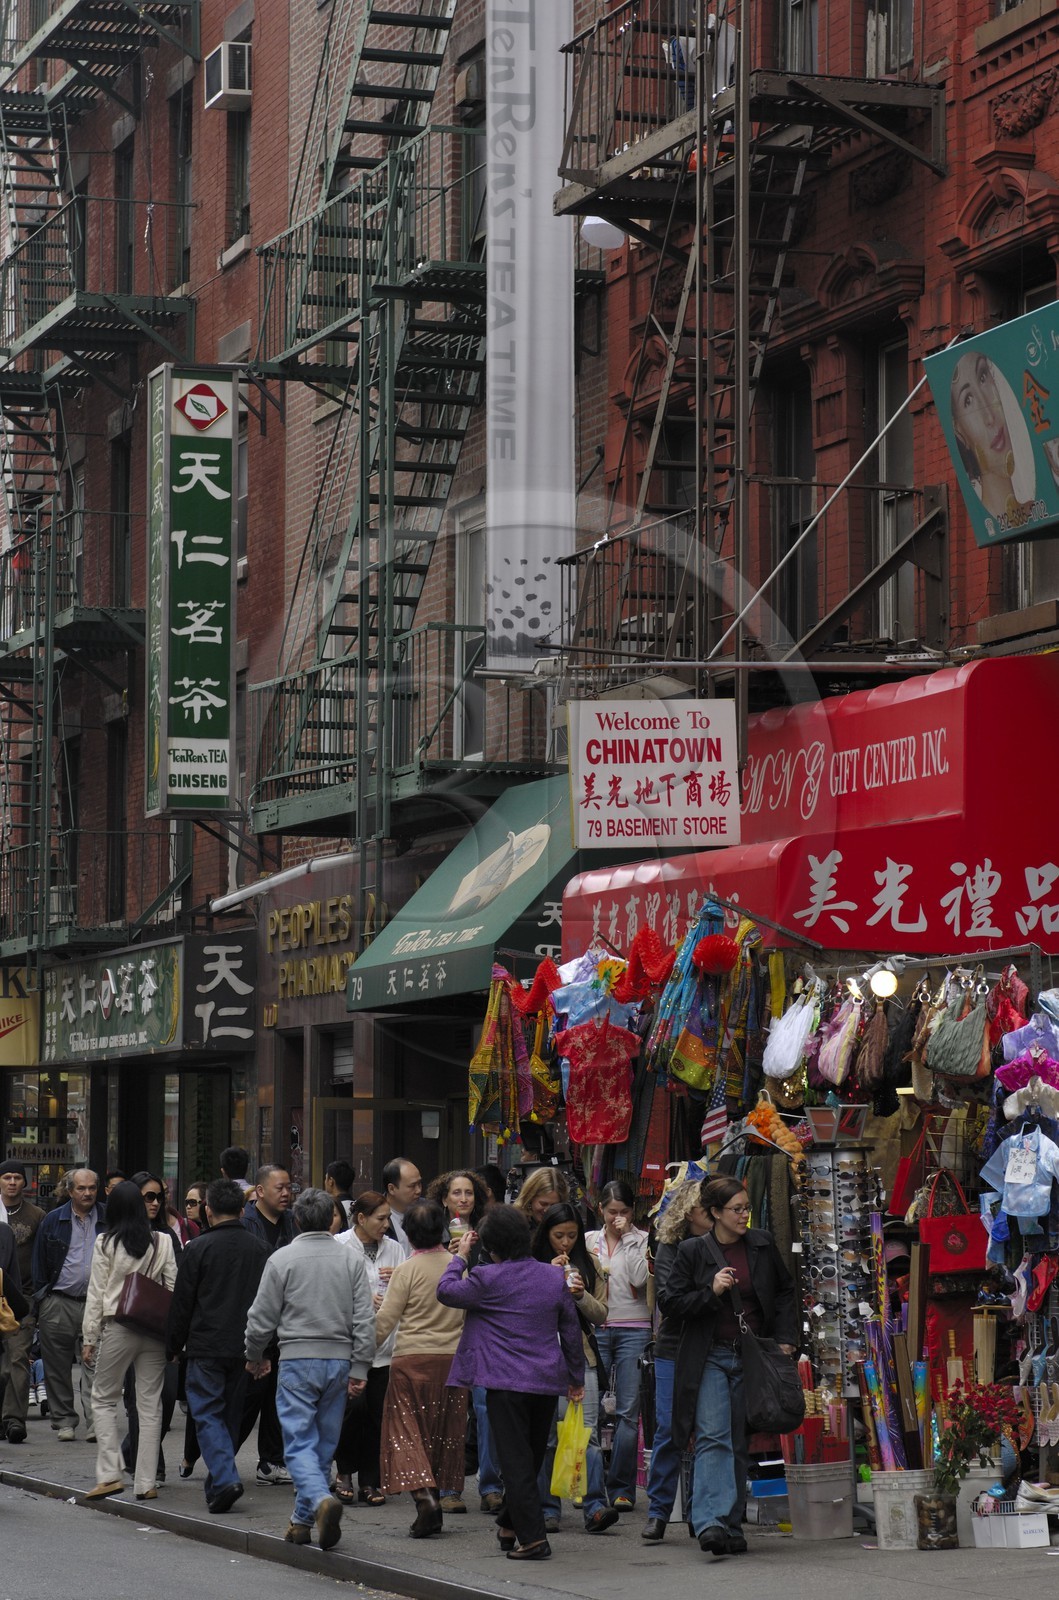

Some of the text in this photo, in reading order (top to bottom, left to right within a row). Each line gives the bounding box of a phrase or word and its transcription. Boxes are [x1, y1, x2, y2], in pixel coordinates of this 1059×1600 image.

[488, 228, 516, 333] TEA
[488, 341, 516, 462] TIME
[169, 452, 231, 724] 天仁茗茶
[595, 711, 711, 731] Welcome To
[208, 749, 228, 763] TEA
[585, 737, 722, 765] CHINATOWN
[829, 747, 861, 797] GIFT
[863, 735, 917, 791] CENTER
[921, 727, 950, 778] INC.
[168, 773, 228, 788] GINSENG
[580, 770, 732, 811] 美光地下商場
[587, 816, 727, 838] 79 BASEMENT STORE
[792, 849, 1059, 938] 美光禮品
[268, 895, 353, 954] PEOPLES
[432, 931, 454, 948] TEA
[453, 925, 484, 944] TIME
[194, 945, 255, 1044] 天仁
[351, 976, 363, 1001] 79
[386, 959, 447, 996] 天仁茗茶
[0, 1013, 23, 1029] IKE
